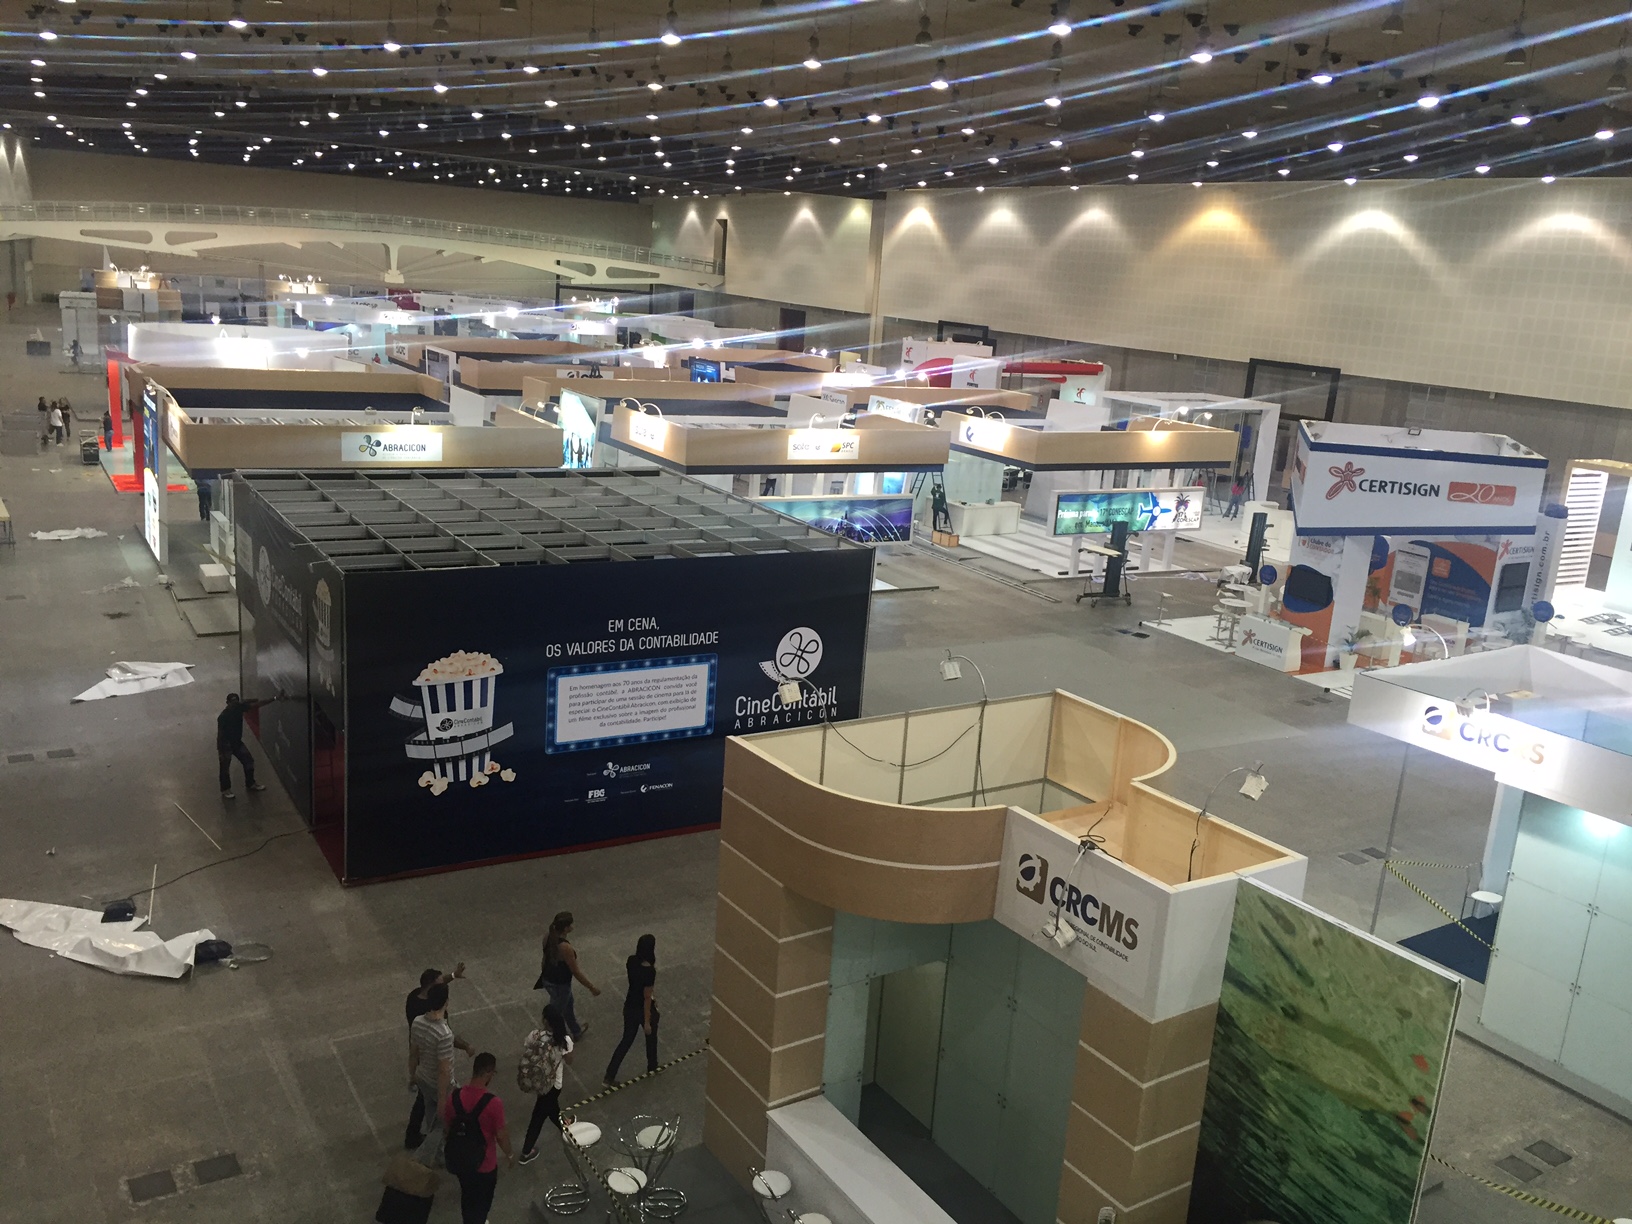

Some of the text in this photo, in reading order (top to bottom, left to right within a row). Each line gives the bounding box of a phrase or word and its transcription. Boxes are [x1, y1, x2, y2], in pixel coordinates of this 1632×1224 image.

[382, 444, 426, 452] ABRACICON
[1358, 478, 1441, 498] CERTISIGN
[1510, 546, 1534, 555] CERTISIGN
[608, 616, 660, 633] EM CENA,
[546, 631, 719, 658] OS VALORES DA CONTABILIDADE
[1253, 638, 1283, 653] CERTISIGN
[579, 682, 611, 690] homenagem
[569, 691, 593, 700] profissão
[582, 699, 607, 707] participar
[597, 703, 630, 712] CineContábil
[734, 707, 838, 730] ABRACICON
[1460, 722, 1545, 764] CRCS
[620, 763, 650, 773] ABRACICON
[588, 789, 605, 798] FBG
[1050, 876, 1139, 951] CRCMS
[1096, 938, 1129, 962] CONTABILIDADE
